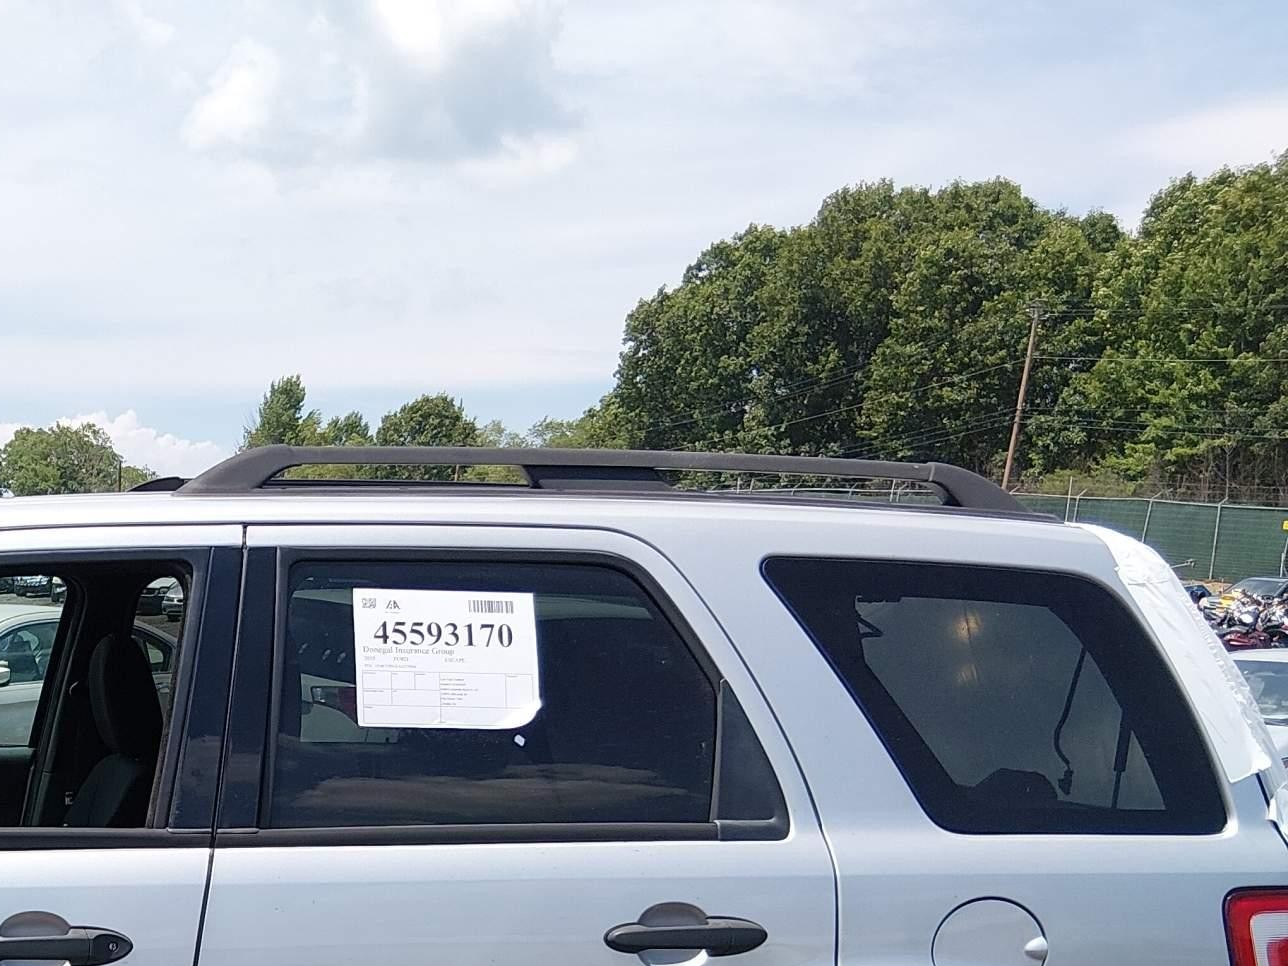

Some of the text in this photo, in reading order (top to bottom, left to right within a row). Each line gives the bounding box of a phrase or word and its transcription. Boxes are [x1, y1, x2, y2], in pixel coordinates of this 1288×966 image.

[373, 620, 513, 648] 45593170
[362, 646, 455, 656] Donegal Insurance Group
